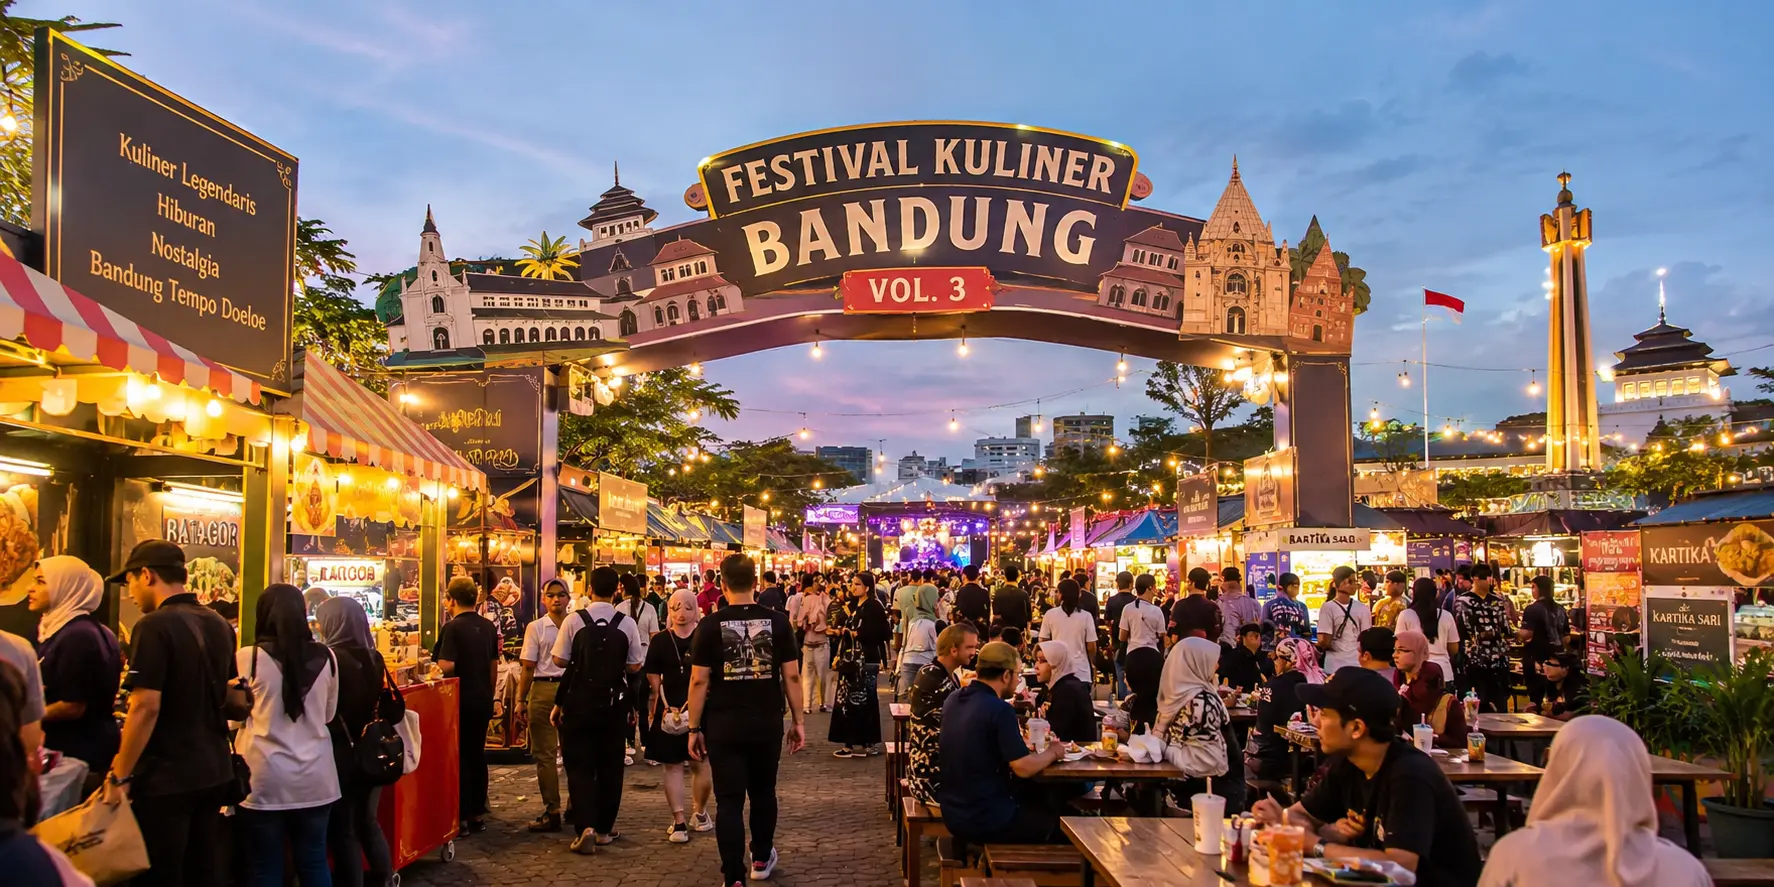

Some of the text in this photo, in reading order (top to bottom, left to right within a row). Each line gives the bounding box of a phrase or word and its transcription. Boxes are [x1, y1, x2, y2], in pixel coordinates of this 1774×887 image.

[119, 132, 257, 216] Kuliner Legendaris
[720, 138, 1116, 203] FESTIVAL KULINER
[157, 192, 216, 238] Hiburan
[741, 196, 1097, 277] BANDUNG
[151, 231, 220, 280] Nostalgia
[89, 249, 266, 331] Bandung Tempo Doeloe
[868, 276, 967, 304] VOL. 3
[1650, 545, 1711, 564] KARTIKA
[1653, 609, 1722, 626] KARTIKA SARI
